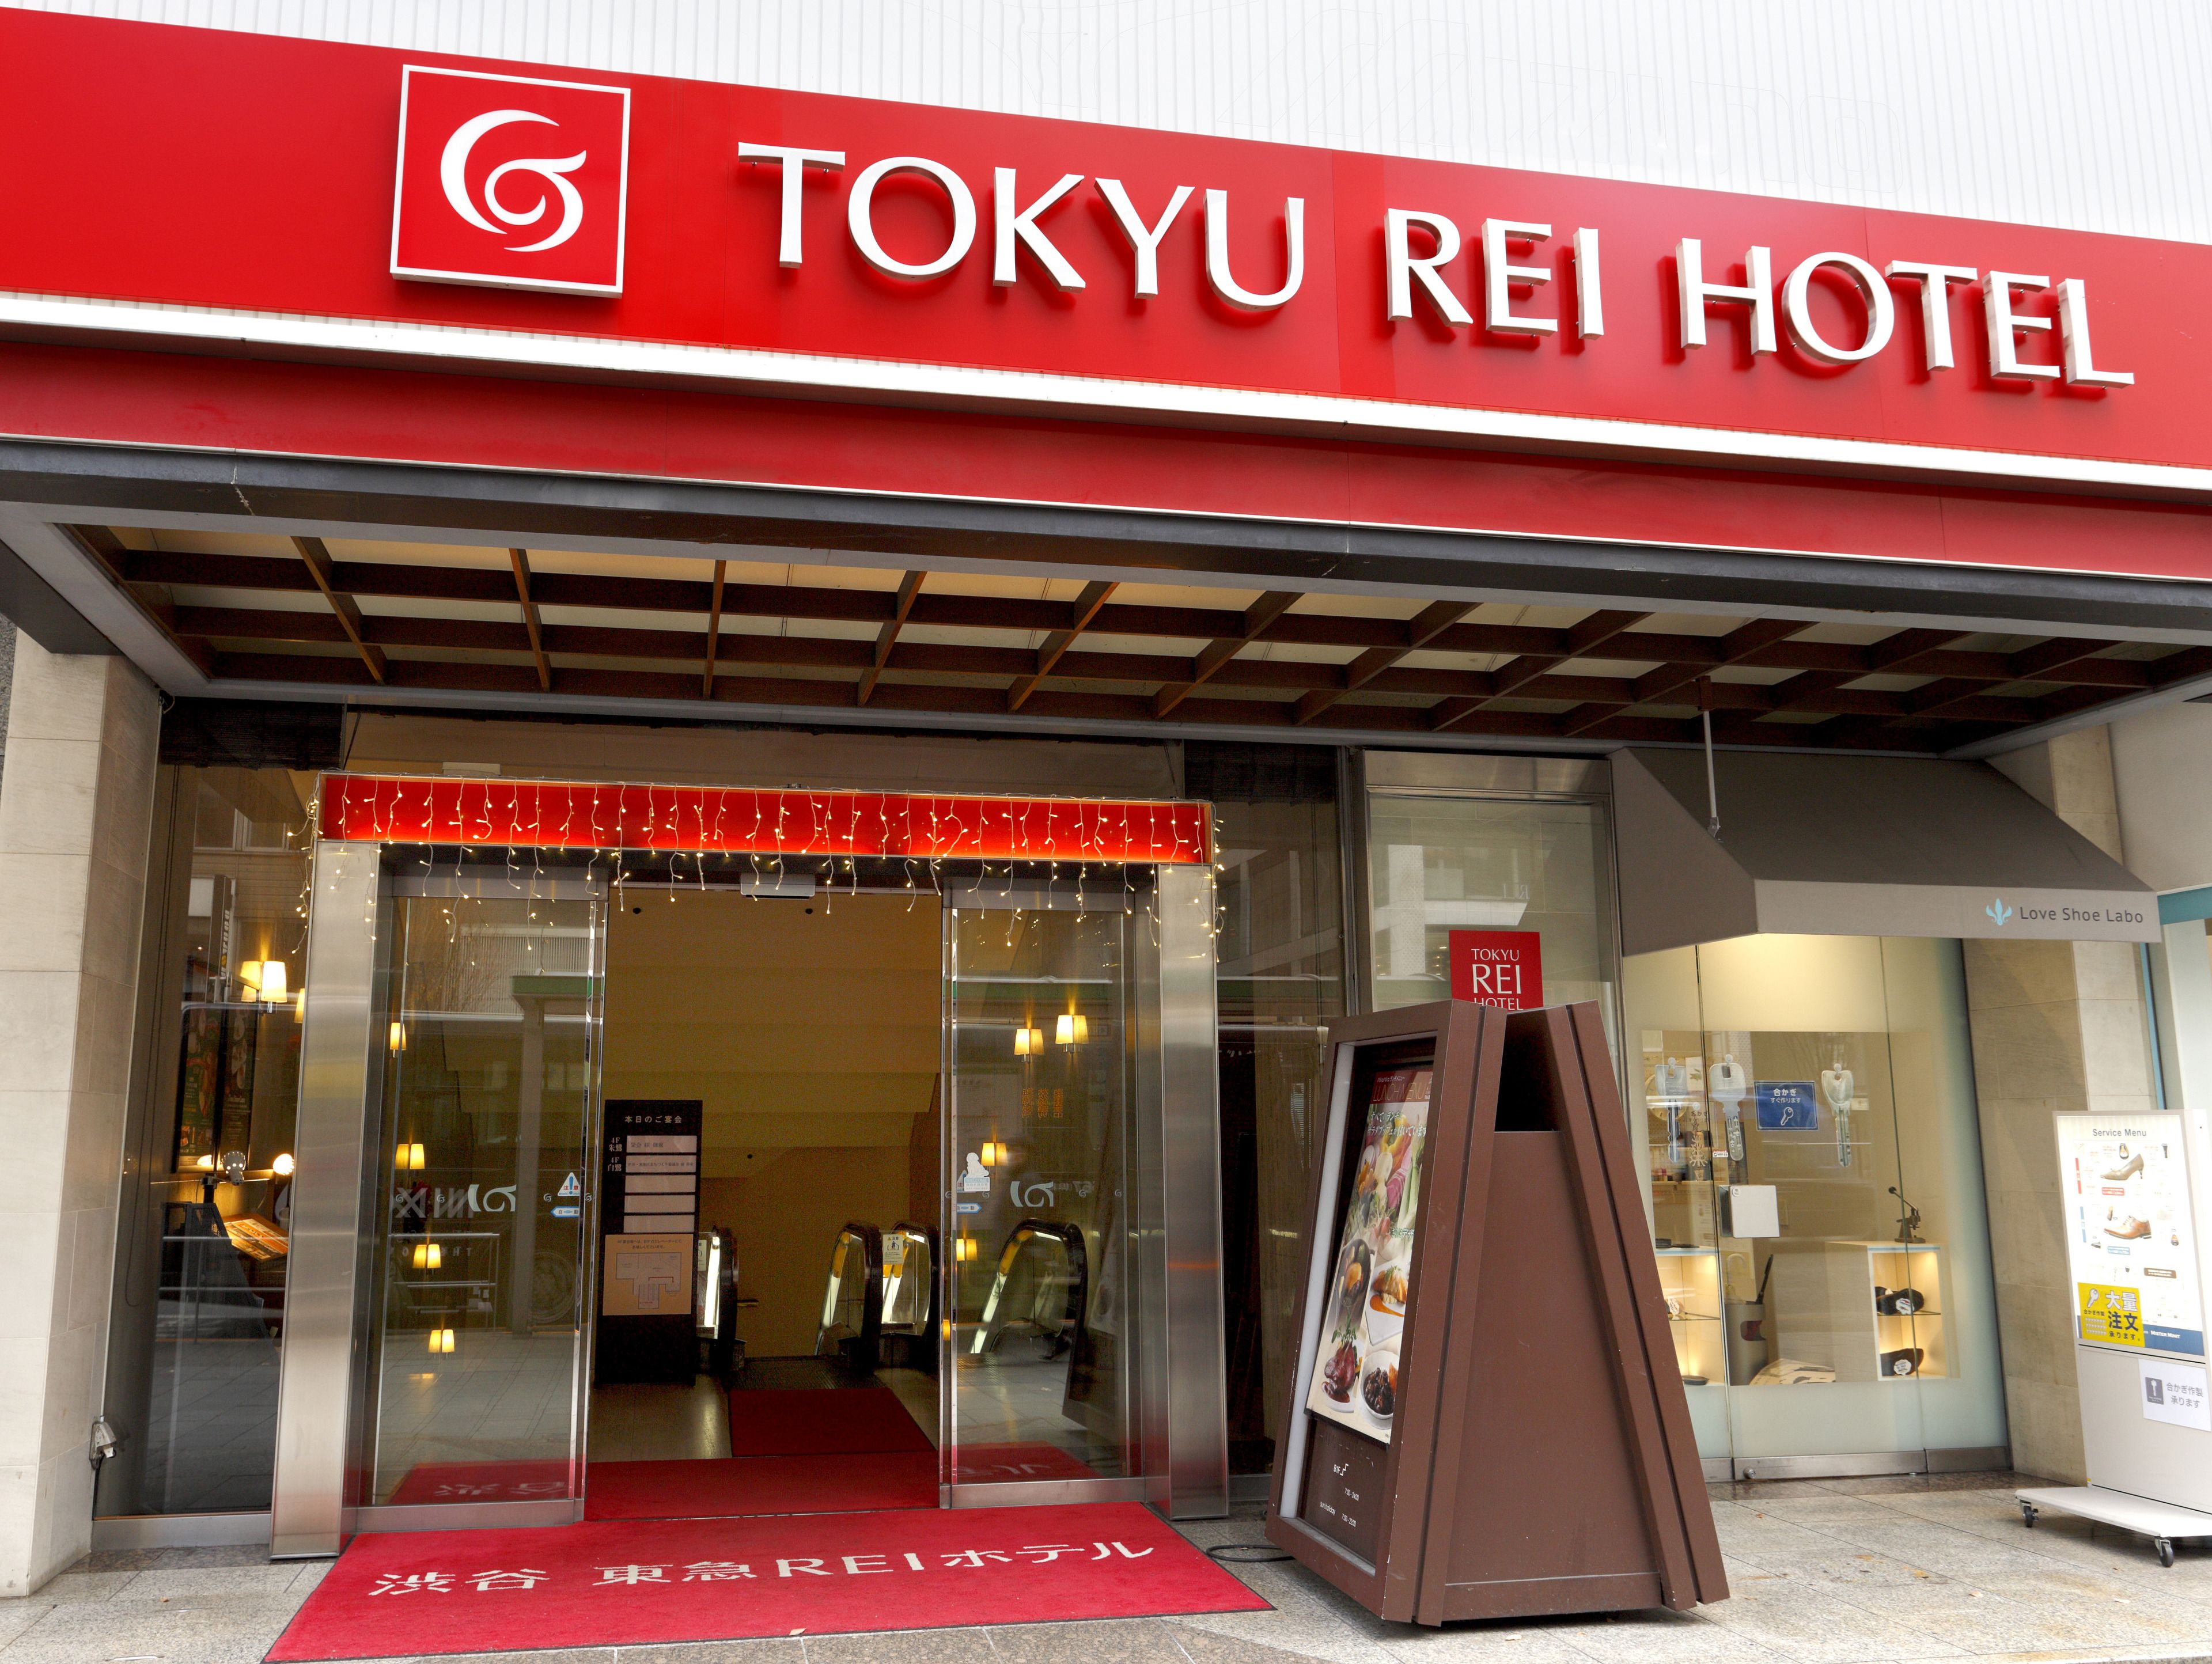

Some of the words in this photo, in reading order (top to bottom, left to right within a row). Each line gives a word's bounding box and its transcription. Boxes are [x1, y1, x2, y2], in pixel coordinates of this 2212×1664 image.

[738, 142, 1305, 312] TOKYU
[1383, 208, 1605, 340] REI
[1676, 237, 2135, 389] HOTEL
[2020, 906, 2056, 920] Love
[2062, 907, 2100, 922] Shoe
[2106, 909, 2143, 923] Labo
[1471, 949, 1519, 961] TOKYU
[1472, 964, 1521, 994] REI
[1773, 1088, 1797, 1097] 合かぎ
[624, 1115, 683, 1124] 本日のご宴会
[2092, 1128, 2122, 1137] Service
[2124, 1128, 2147, 1137] Menu
[2105, 1291, 2138, 1312] 大量
[2108, 1310, 2139, 1332] 注文
[2166, 1382, 2203, 1397] 合かぎ作製
[2171, 1395, 2200, 1409] 承ります
[368, 1568, 550, 1596] 渋谷
